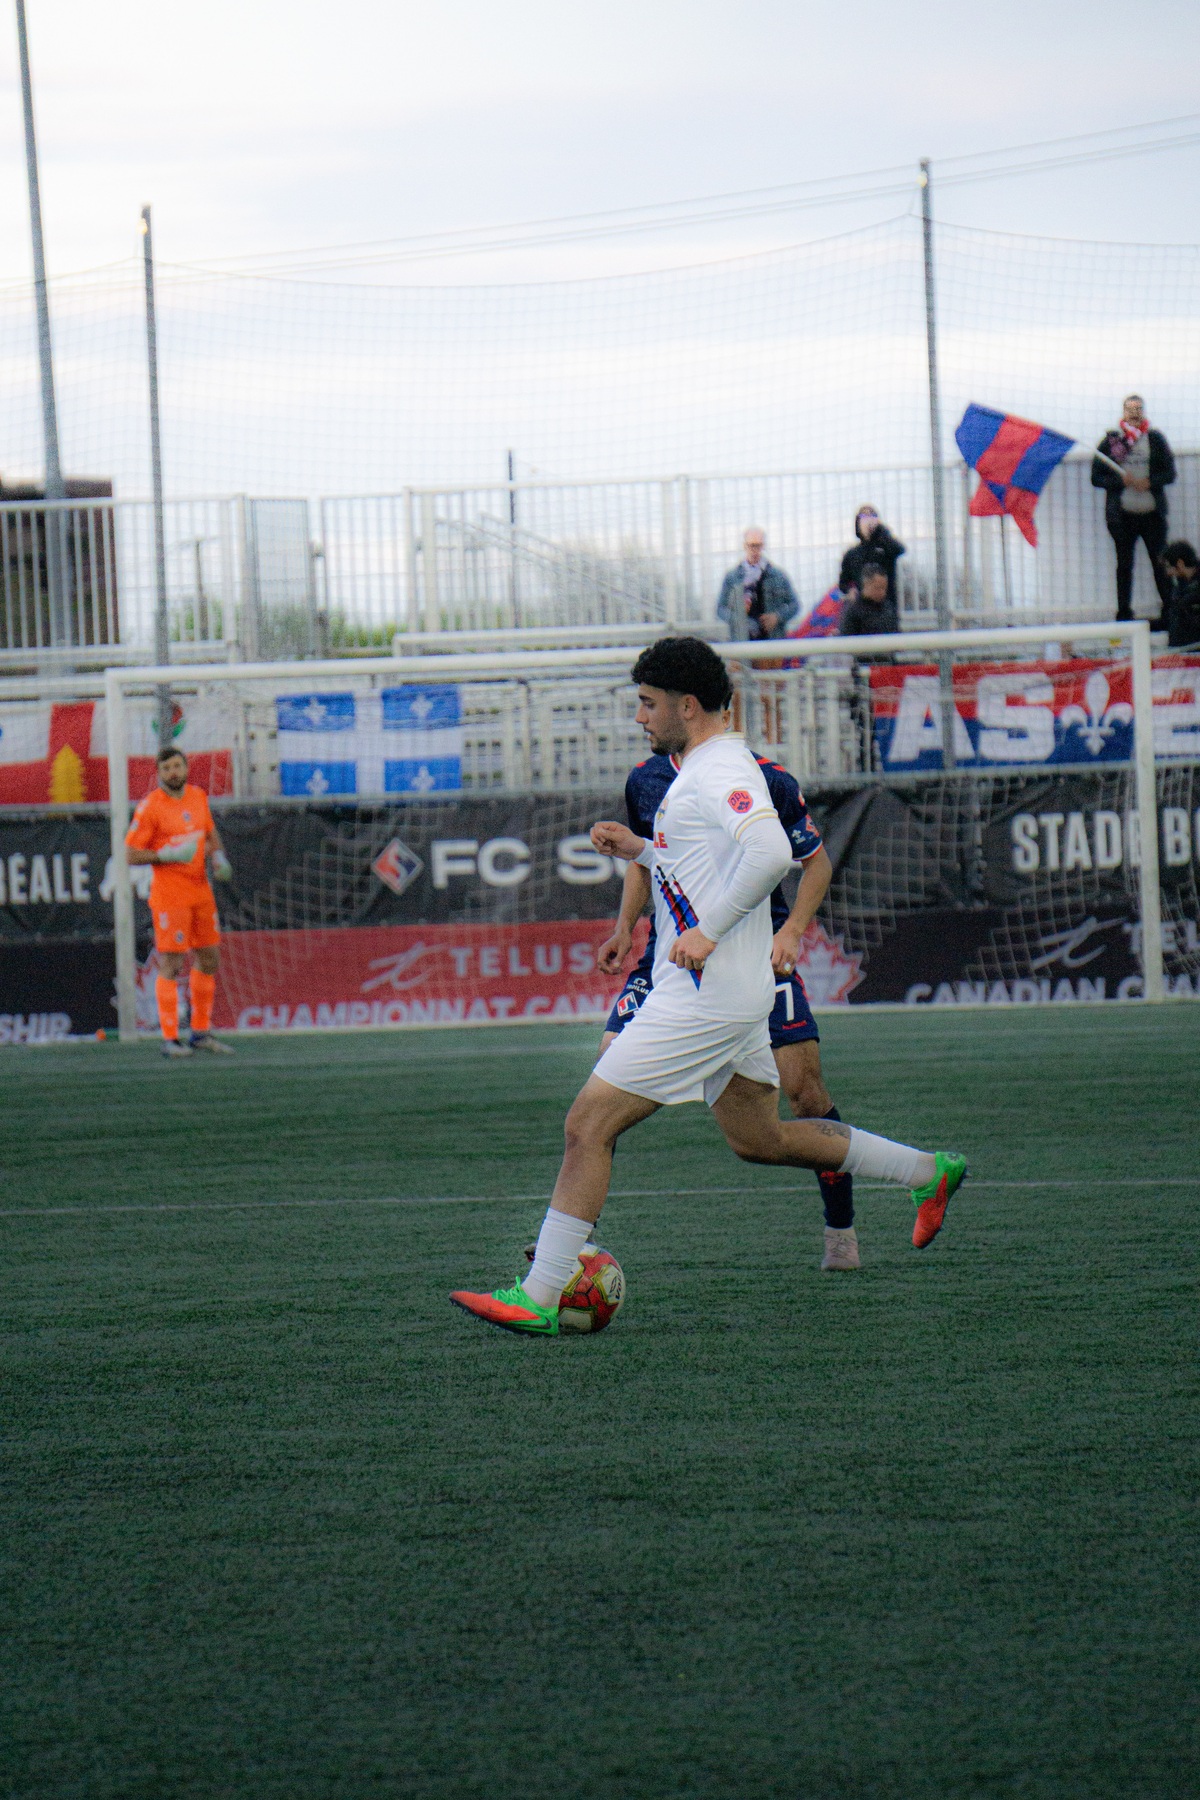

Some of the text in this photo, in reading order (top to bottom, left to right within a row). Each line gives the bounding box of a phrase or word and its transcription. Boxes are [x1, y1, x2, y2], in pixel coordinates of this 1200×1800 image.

[887, 671, 1055, 762] AS
[1163, 806, 1200, 867] B
[431, 833, 627, 889] FC S
[450, 942, 596, 979] TELUS
[237, 996, 516, 1030] CHAMPIONNAT
[906, 976, 1107, 1004] CANADIAN
